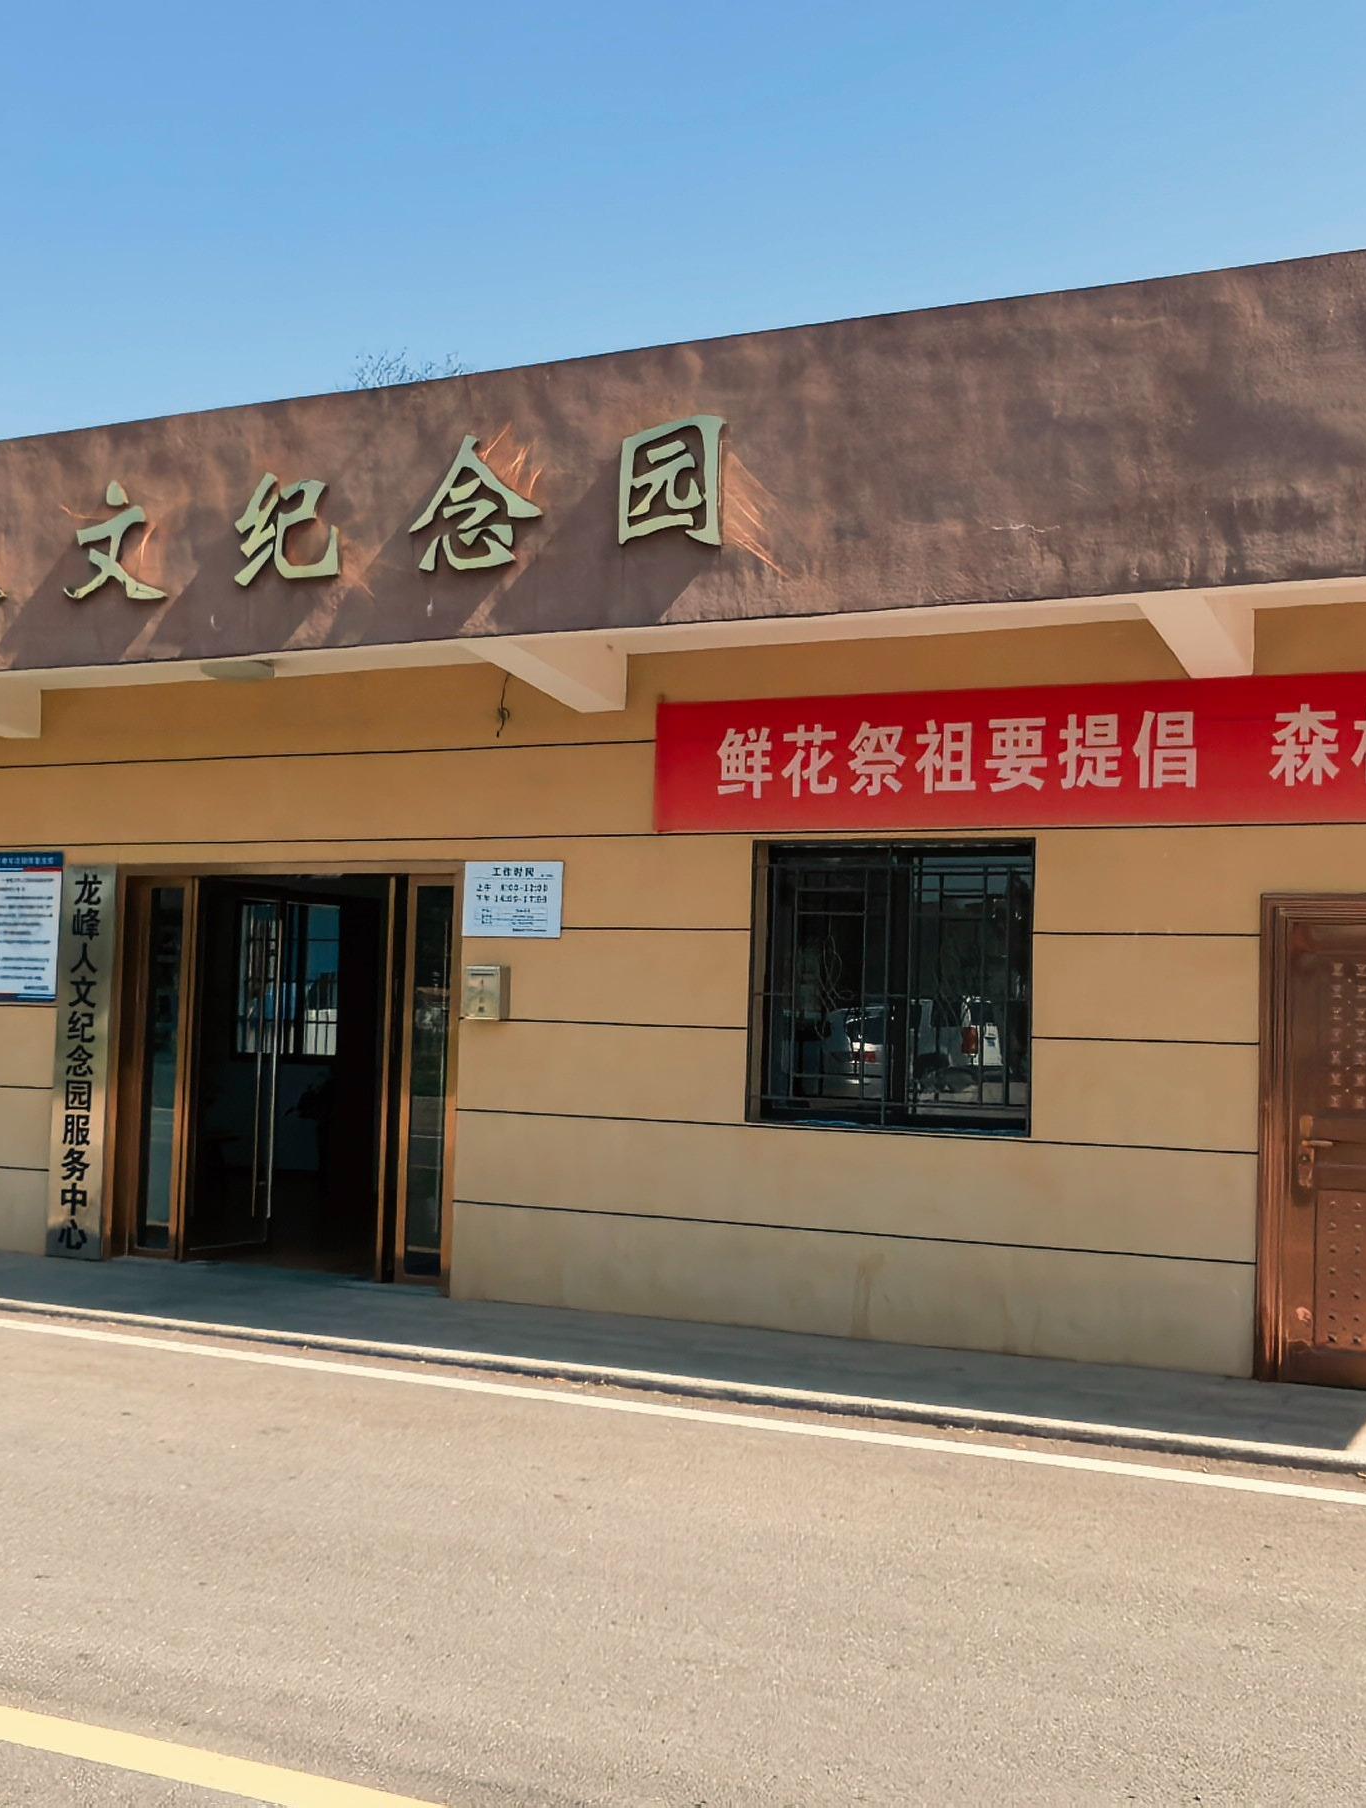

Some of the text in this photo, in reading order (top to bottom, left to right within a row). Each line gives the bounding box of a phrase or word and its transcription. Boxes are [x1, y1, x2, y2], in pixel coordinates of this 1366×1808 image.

[717, 710, 1197, 799] 鲜花祭祖要提倡
[57, 873, 103, 1250] 龙峰人文纪念园服务中心
